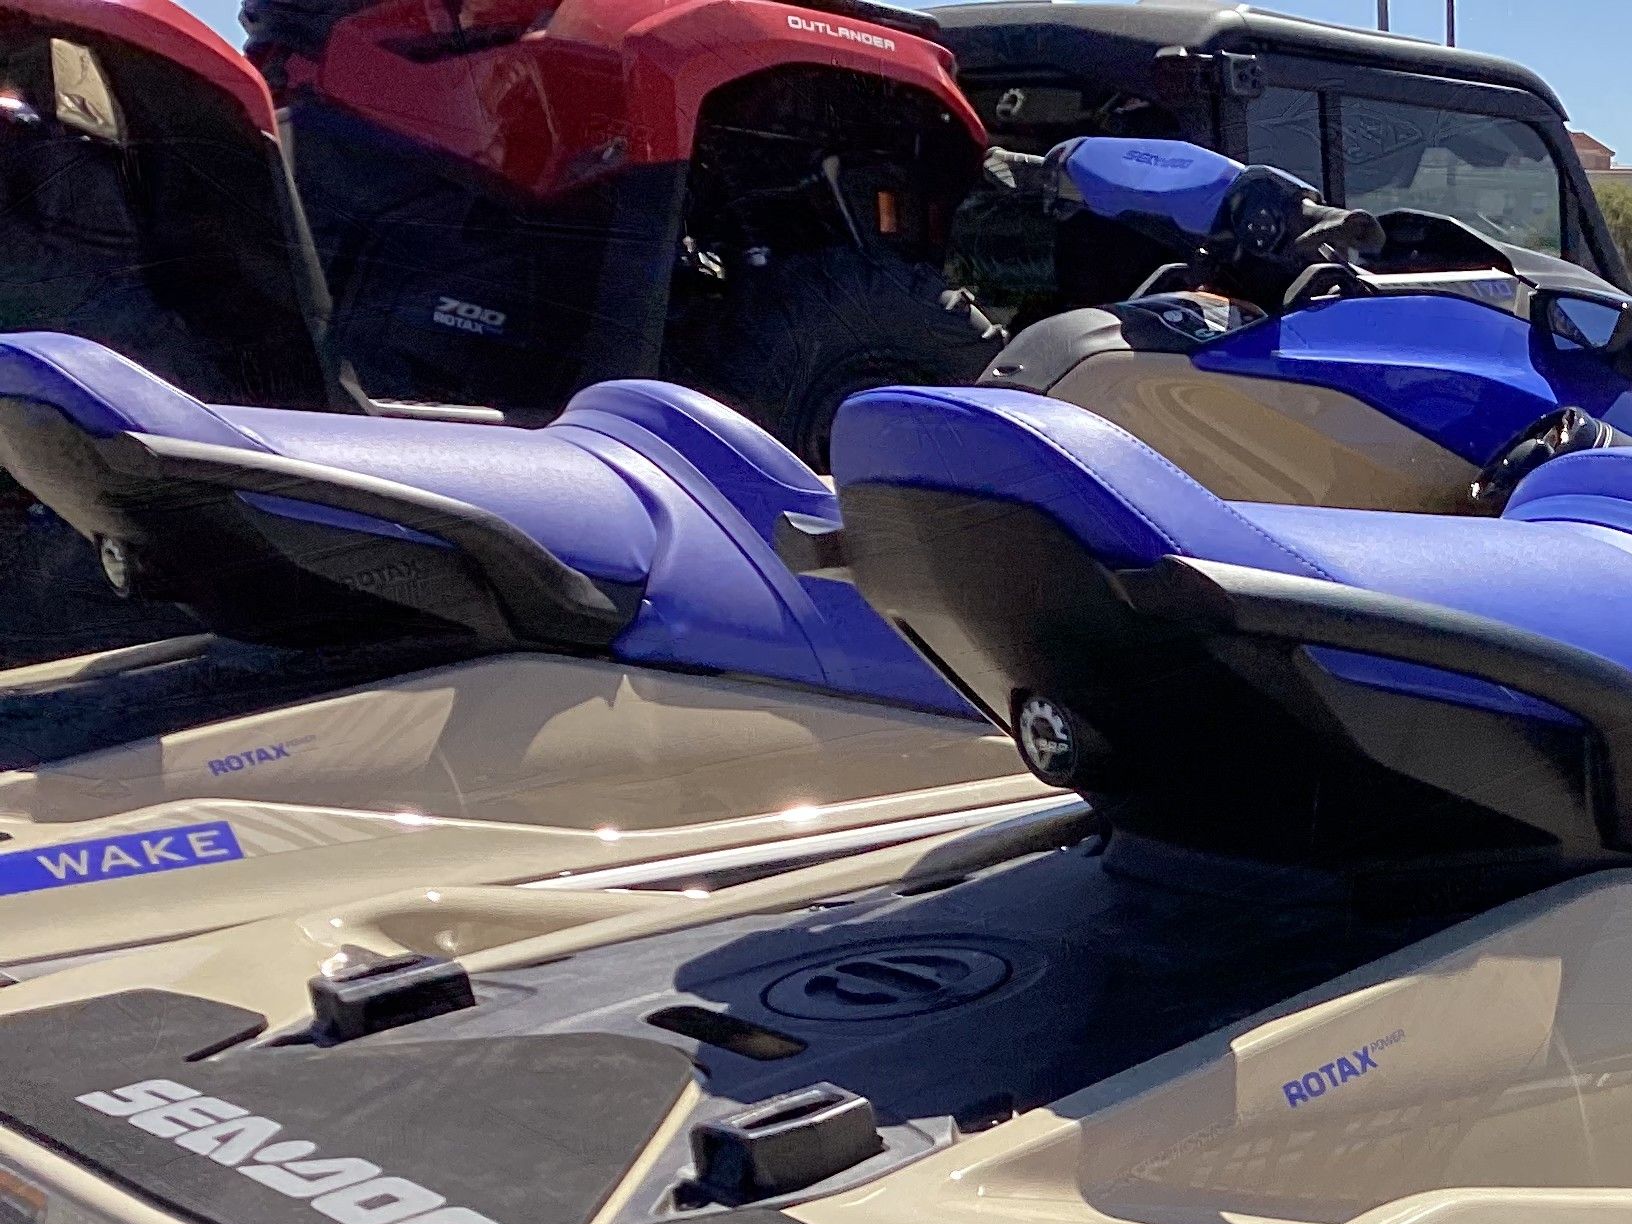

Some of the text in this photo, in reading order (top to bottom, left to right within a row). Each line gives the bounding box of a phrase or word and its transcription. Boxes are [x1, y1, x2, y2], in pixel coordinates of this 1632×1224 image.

[787, 15, 896, 52] OUTLANDER
[437, 295, 507, 327] 700
[207, 742, 291, 776] ROTAX
[36, 829, 230, 880] WAKE
[1282, 1045, 1378, 1108] ROTAX
